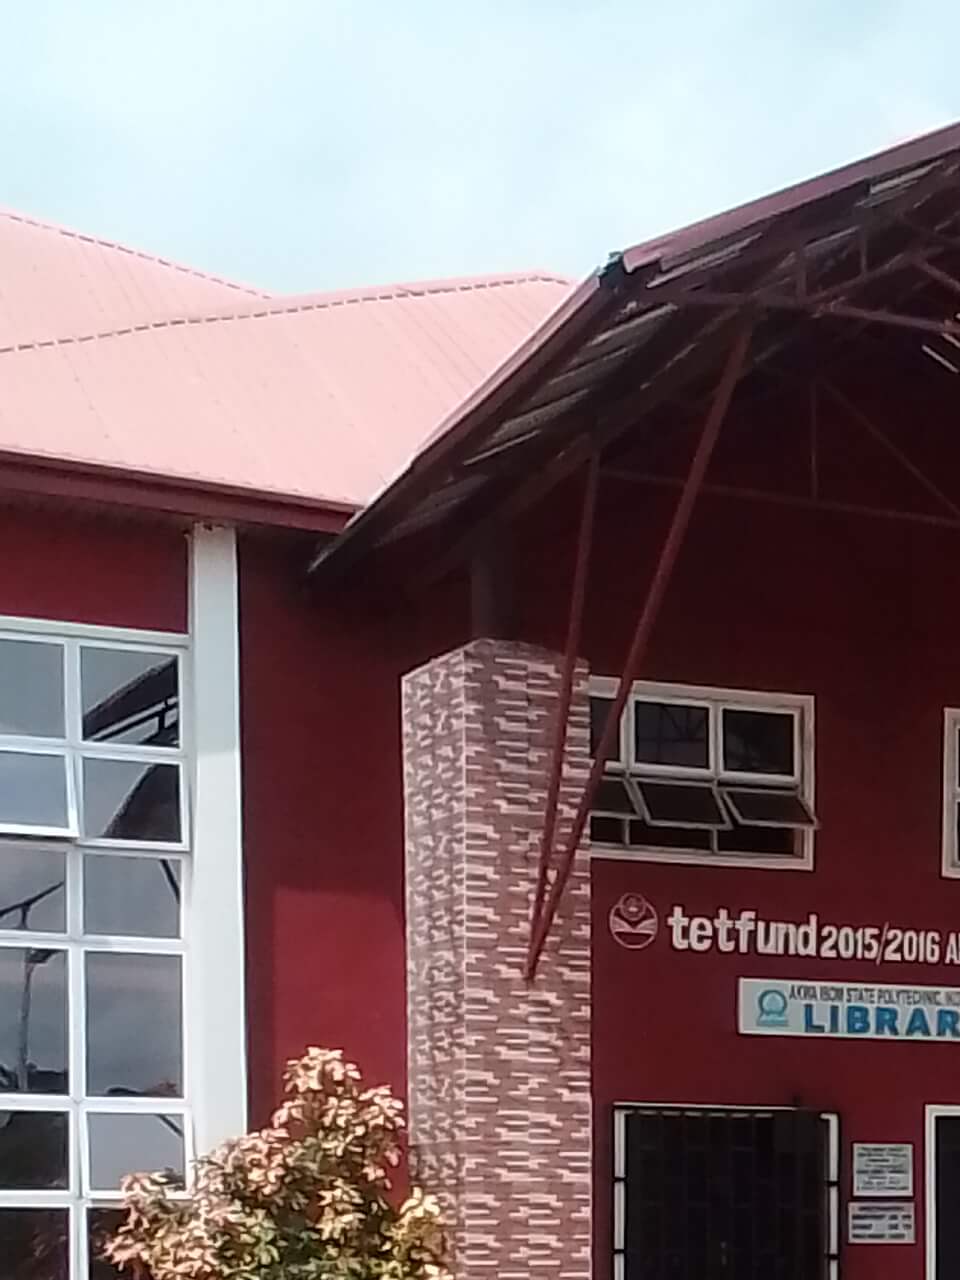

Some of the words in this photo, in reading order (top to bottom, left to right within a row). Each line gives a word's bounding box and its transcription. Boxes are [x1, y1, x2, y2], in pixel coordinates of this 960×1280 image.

[667, 906, 817, 956] tetfund
[820, 922, 941, 965] 2015/2016
[846, 987, 875, 1004] STATE
